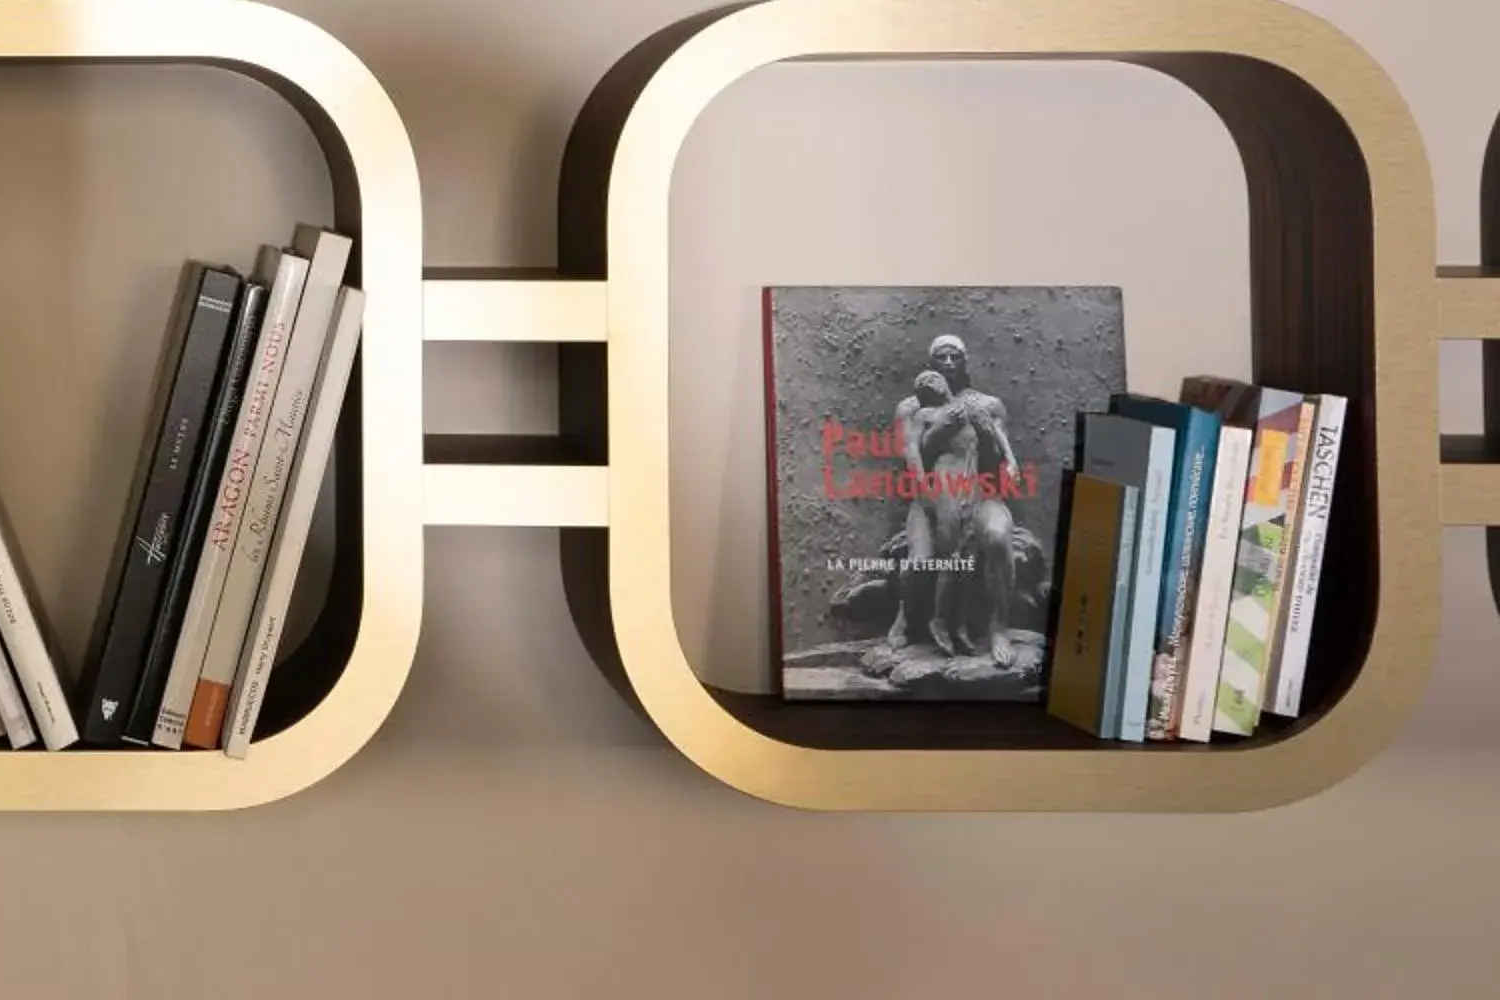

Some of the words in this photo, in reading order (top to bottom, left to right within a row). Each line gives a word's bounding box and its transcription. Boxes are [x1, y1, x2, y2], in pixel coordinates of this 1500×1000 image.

[208, 447, 252, 550] ARAGON
[242, 380, 271, 439] PARMI
[259, 320, 286, 375] NOUS
[822, 416, 906, 457] Paul
[822, 460, 1038, 501] Landowski
[1305, 422, 1340, 519] TASCHEN
[827, 558, 846, 571] LA
[850, 557, 896, 571] PIERRE
